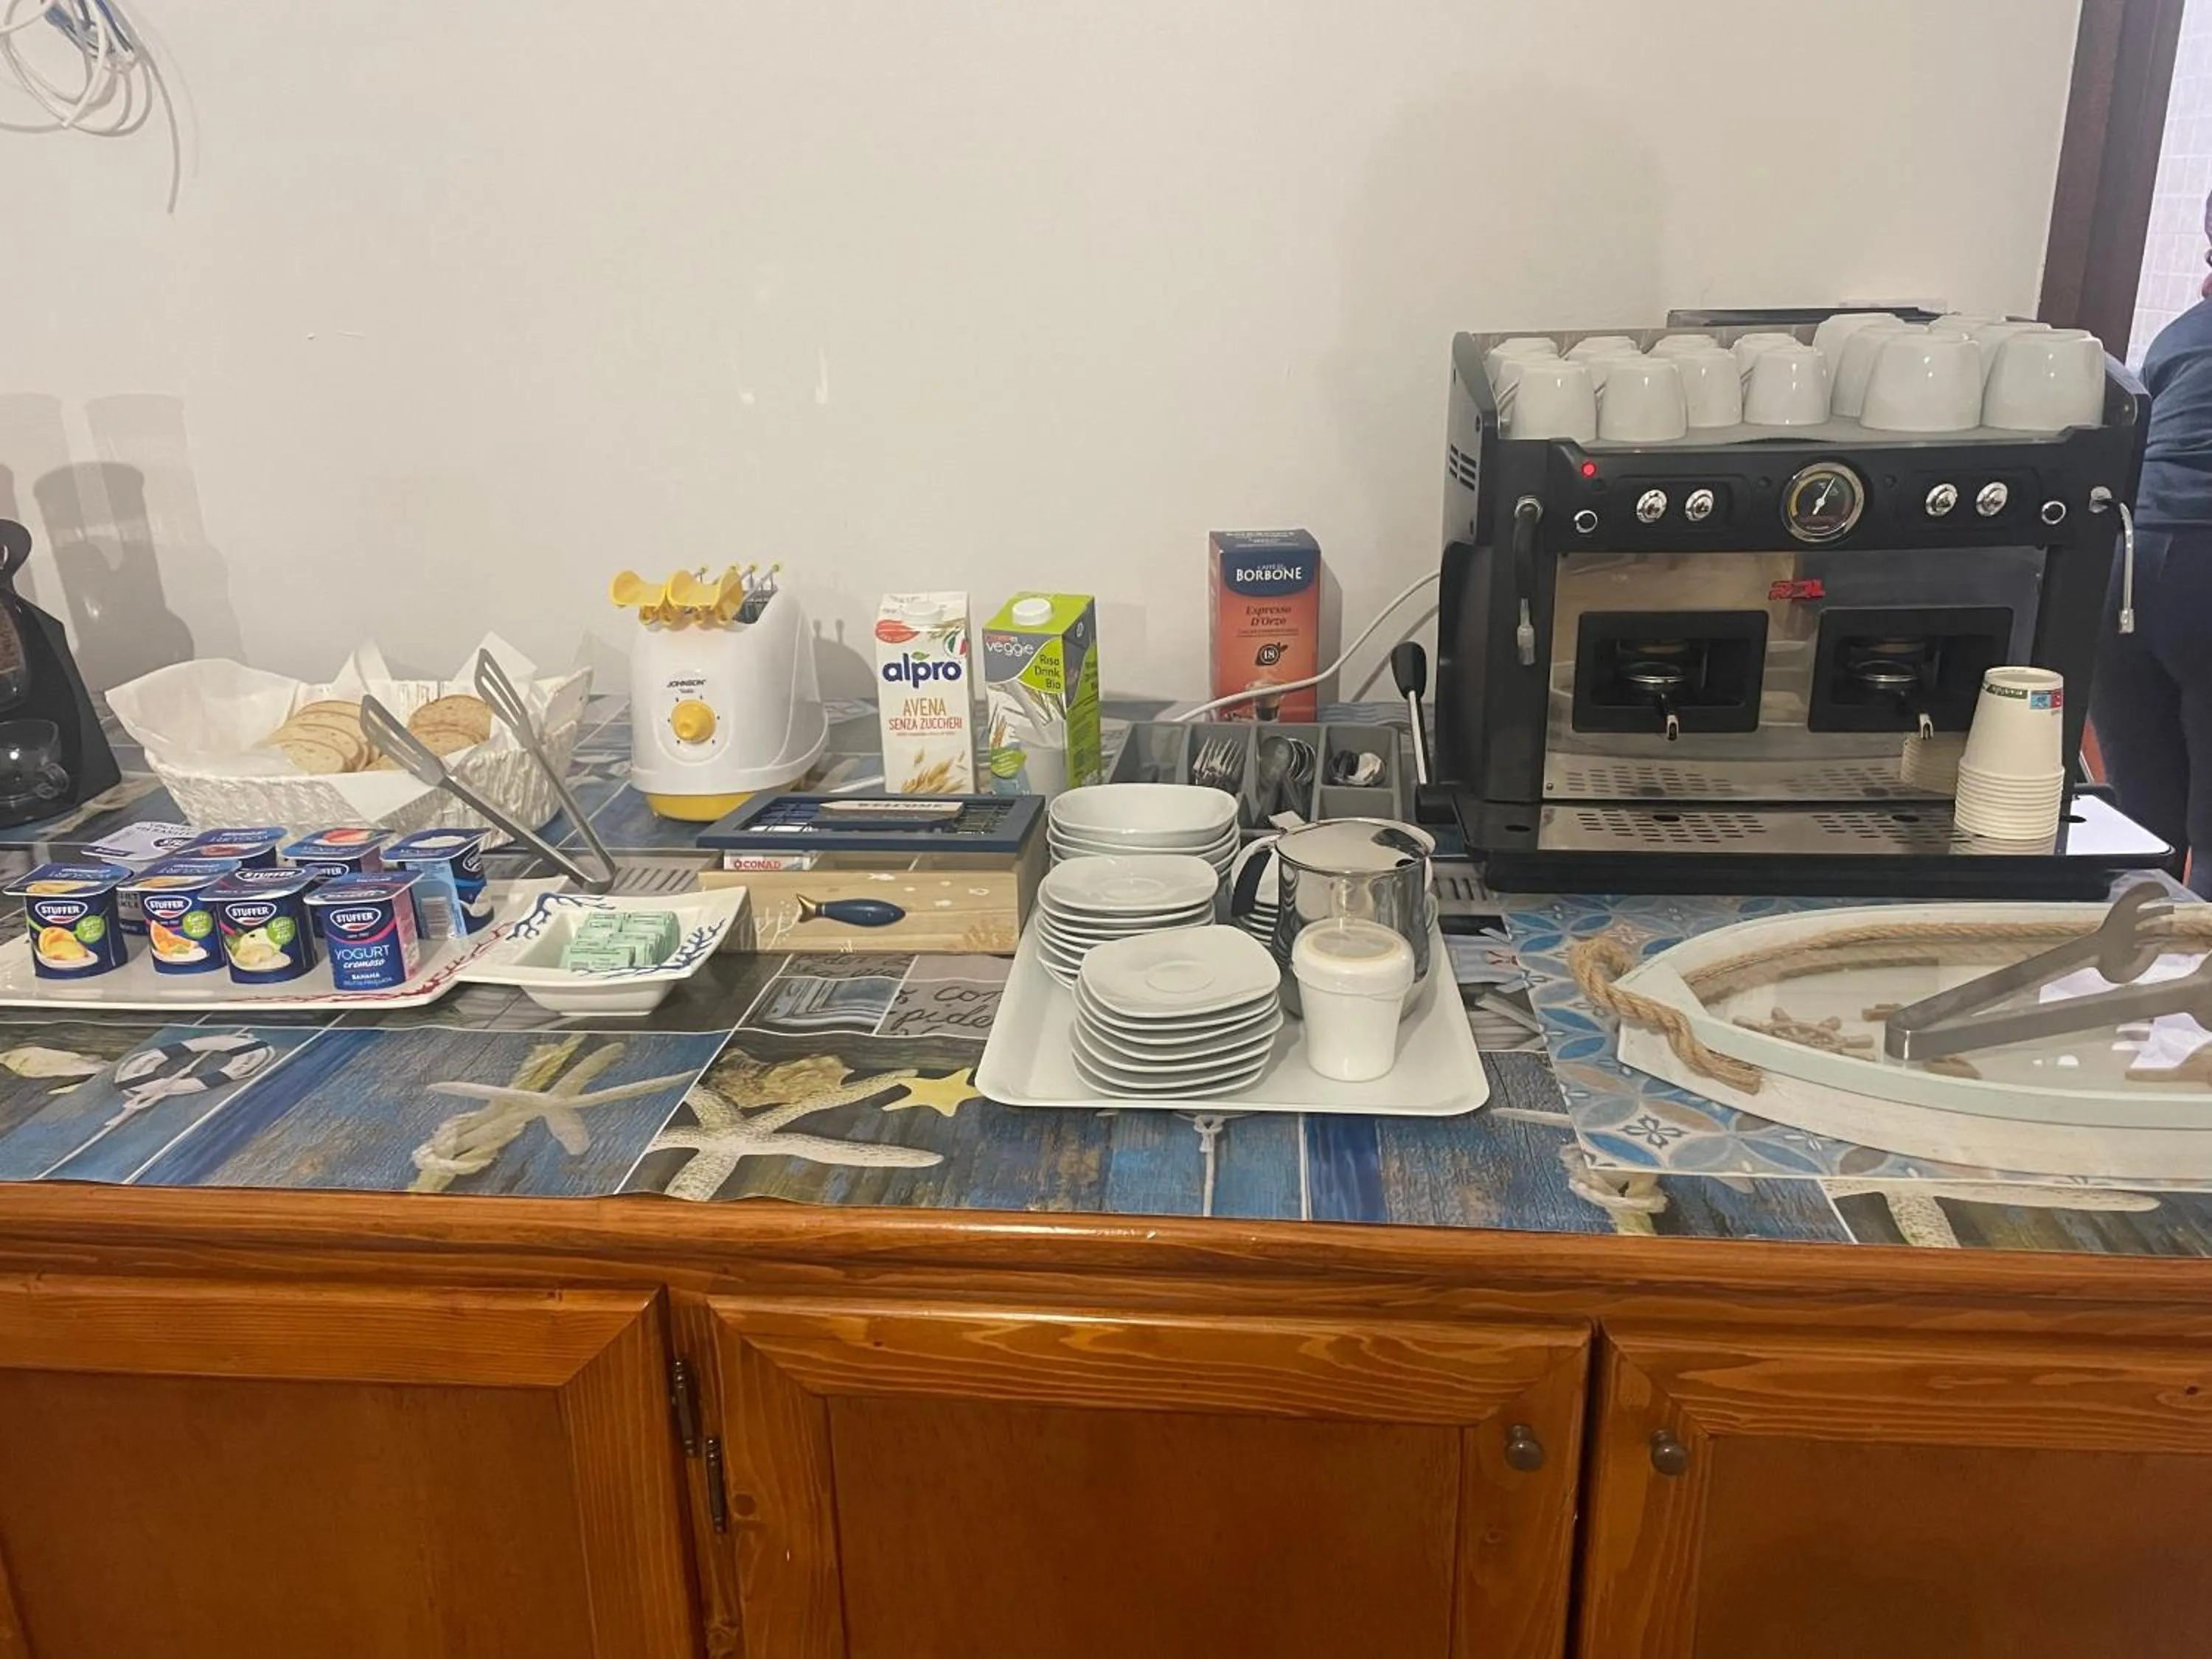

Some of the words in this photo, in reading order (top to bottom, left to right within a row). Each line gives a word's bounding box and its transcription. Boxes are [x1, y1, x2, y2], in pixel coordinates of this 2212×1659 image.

[1236, 567, 1302, 582] BORBONE
[986, 641, 1034, 657] veggie
[1263, 649, 1275, 660] 18
[883, 653, 961, 689] alpro
[1034, 665, 1060, 677] Drink
[903, 698, 947, 717] AVENA
[888, 717, 918, 731] SENZA
[919, 716, 962, 729] ZUCCHERI
[742, 860, 781, 869] CONAD
[40, 905, 80, 915] STUFFER
[149, 900, 184, 909] STUFFER
[231, 906, 270, 917] STUFFER
[335, 912, 374, 923] STUFFER
[334, 944, 390, 961] YOGURT
[342, 959, 386, 969] cremoso
